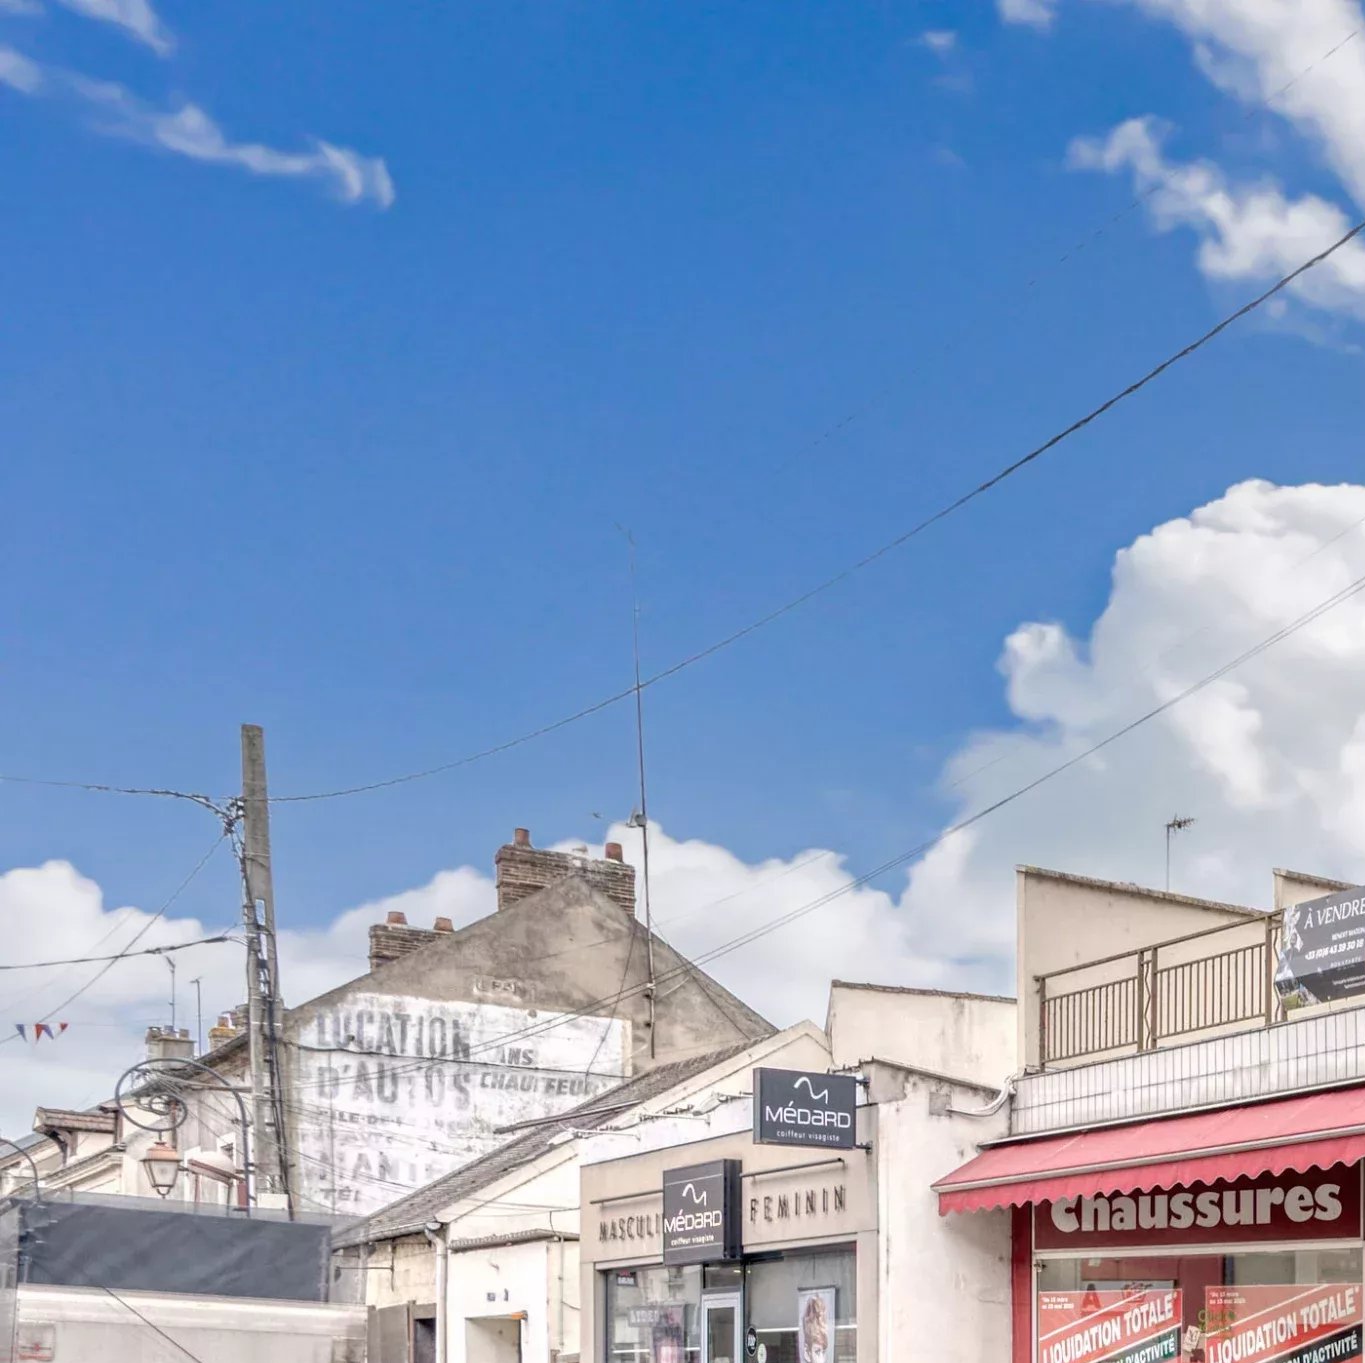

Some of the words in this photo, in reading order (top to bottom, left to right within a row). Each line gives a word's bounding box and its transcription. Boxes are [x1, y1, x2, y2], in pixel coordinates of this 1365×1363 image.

[1304, 908, 1313, 929] À
[776, 1129, 806, 1139] coiffeur
[808, 1131, 840, 1141] visagiste
[750, 1184, 846, 1223] FEMININ
[1050, 1183, 1342, 1233] Chaussures
[599, 1213, 664, 1242] MASCULI
